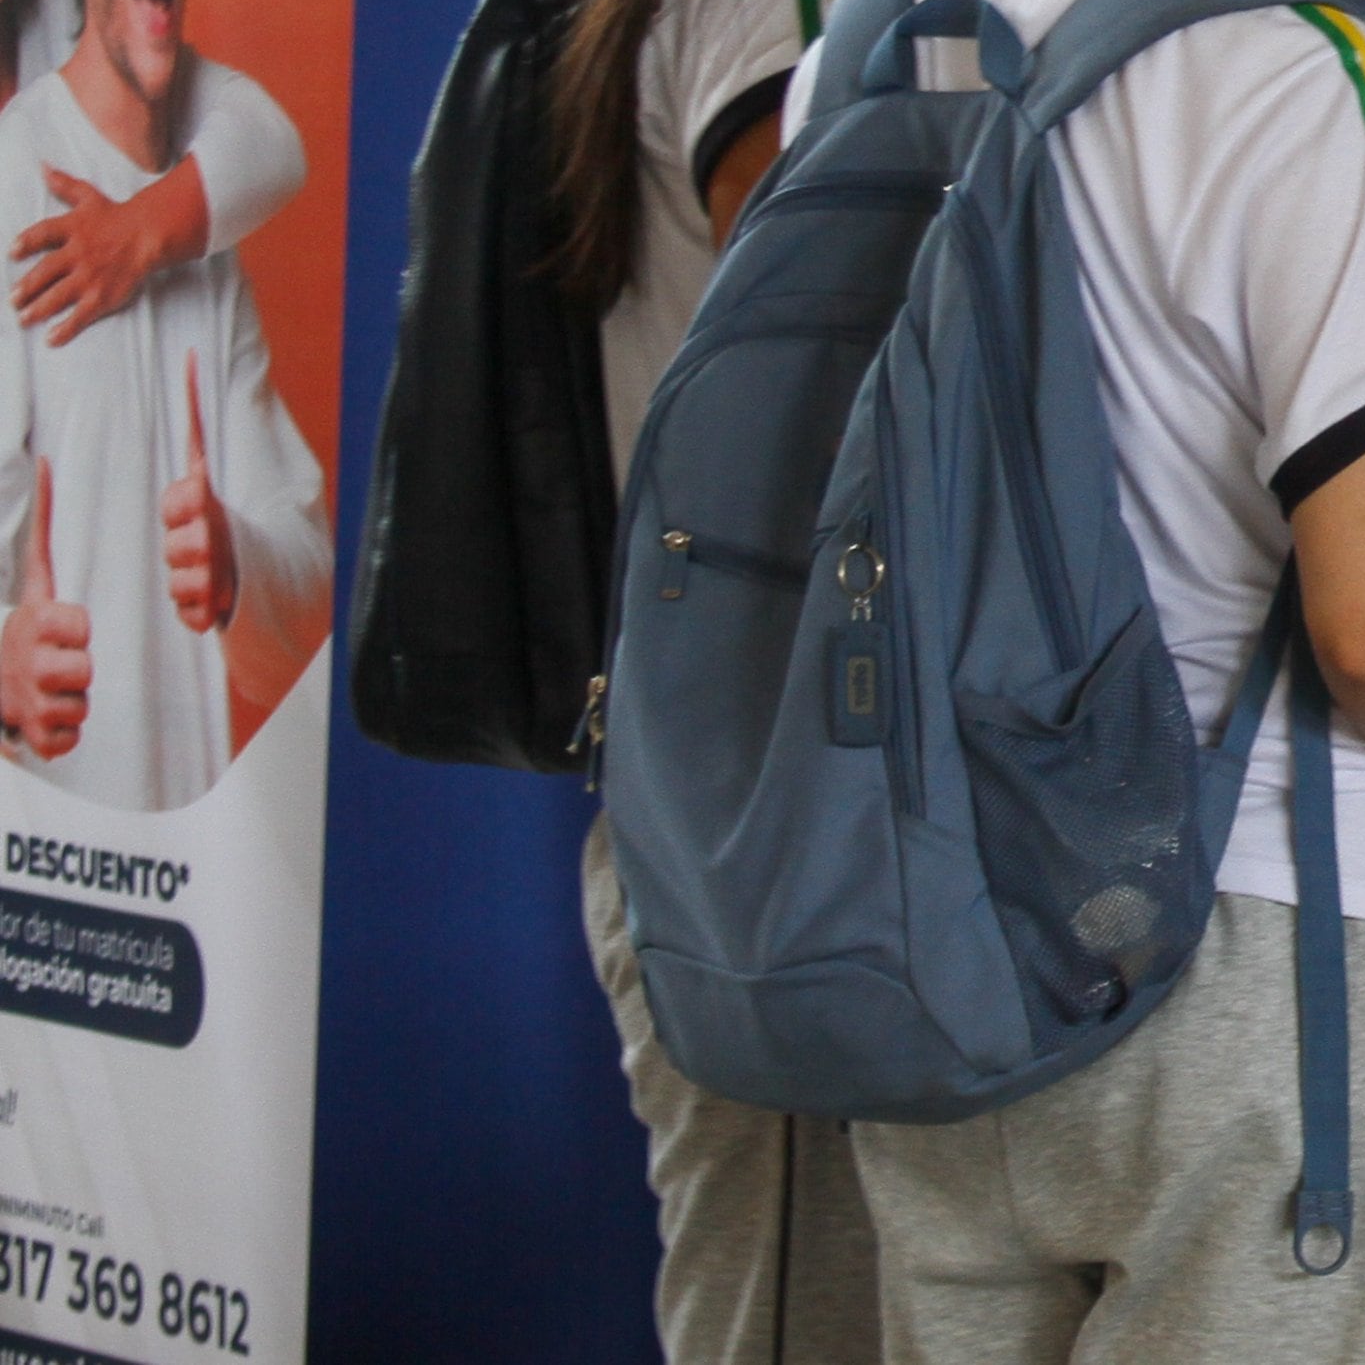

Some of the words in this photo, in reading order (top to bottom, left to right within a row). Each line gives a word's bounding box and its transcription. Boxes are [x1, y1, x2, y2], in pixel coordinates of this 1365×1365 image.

[0, 1229, 54, 1303] 317
[67, 1245, 144, 1327] 369
[158, 1268, 250, 1358] 8612
